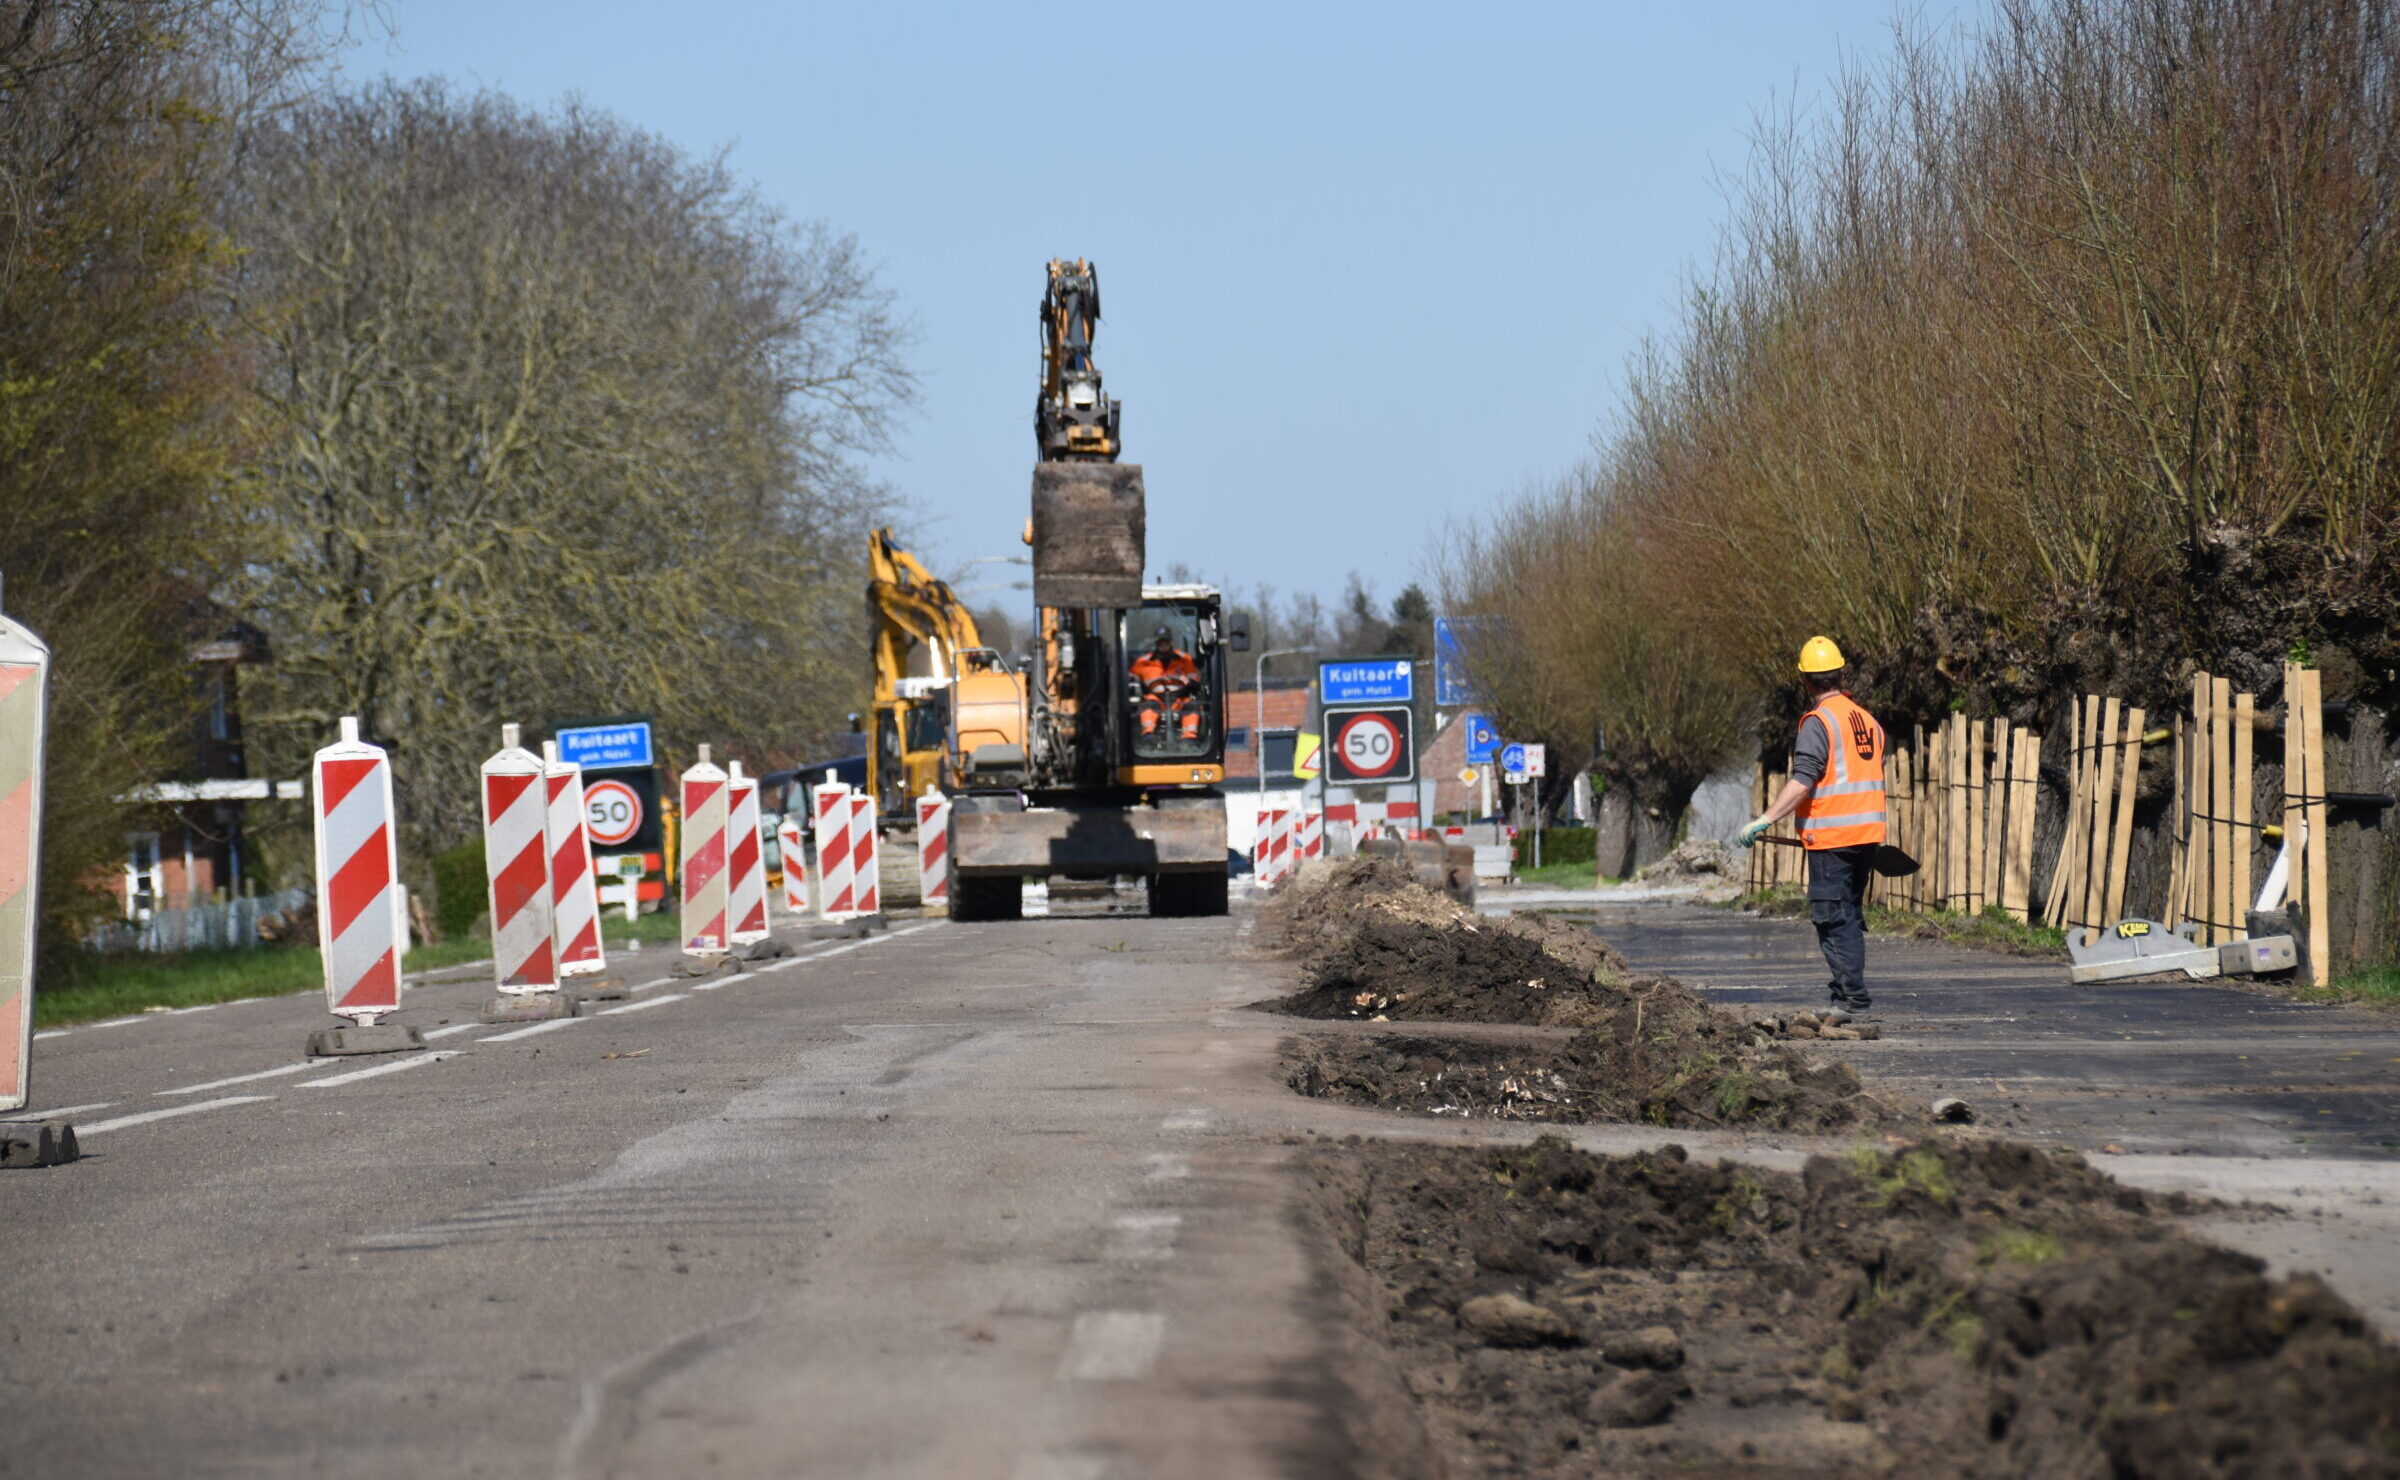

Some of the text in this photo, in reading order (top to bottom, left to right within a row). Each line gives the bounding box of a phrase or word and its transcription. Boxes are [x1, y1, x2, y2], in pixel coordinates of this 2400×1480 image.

[1329, 667, 1402, 683] Kuitaart
[1350, 733, 1390, 756] 50
[591, 800, 628, 823] 50
